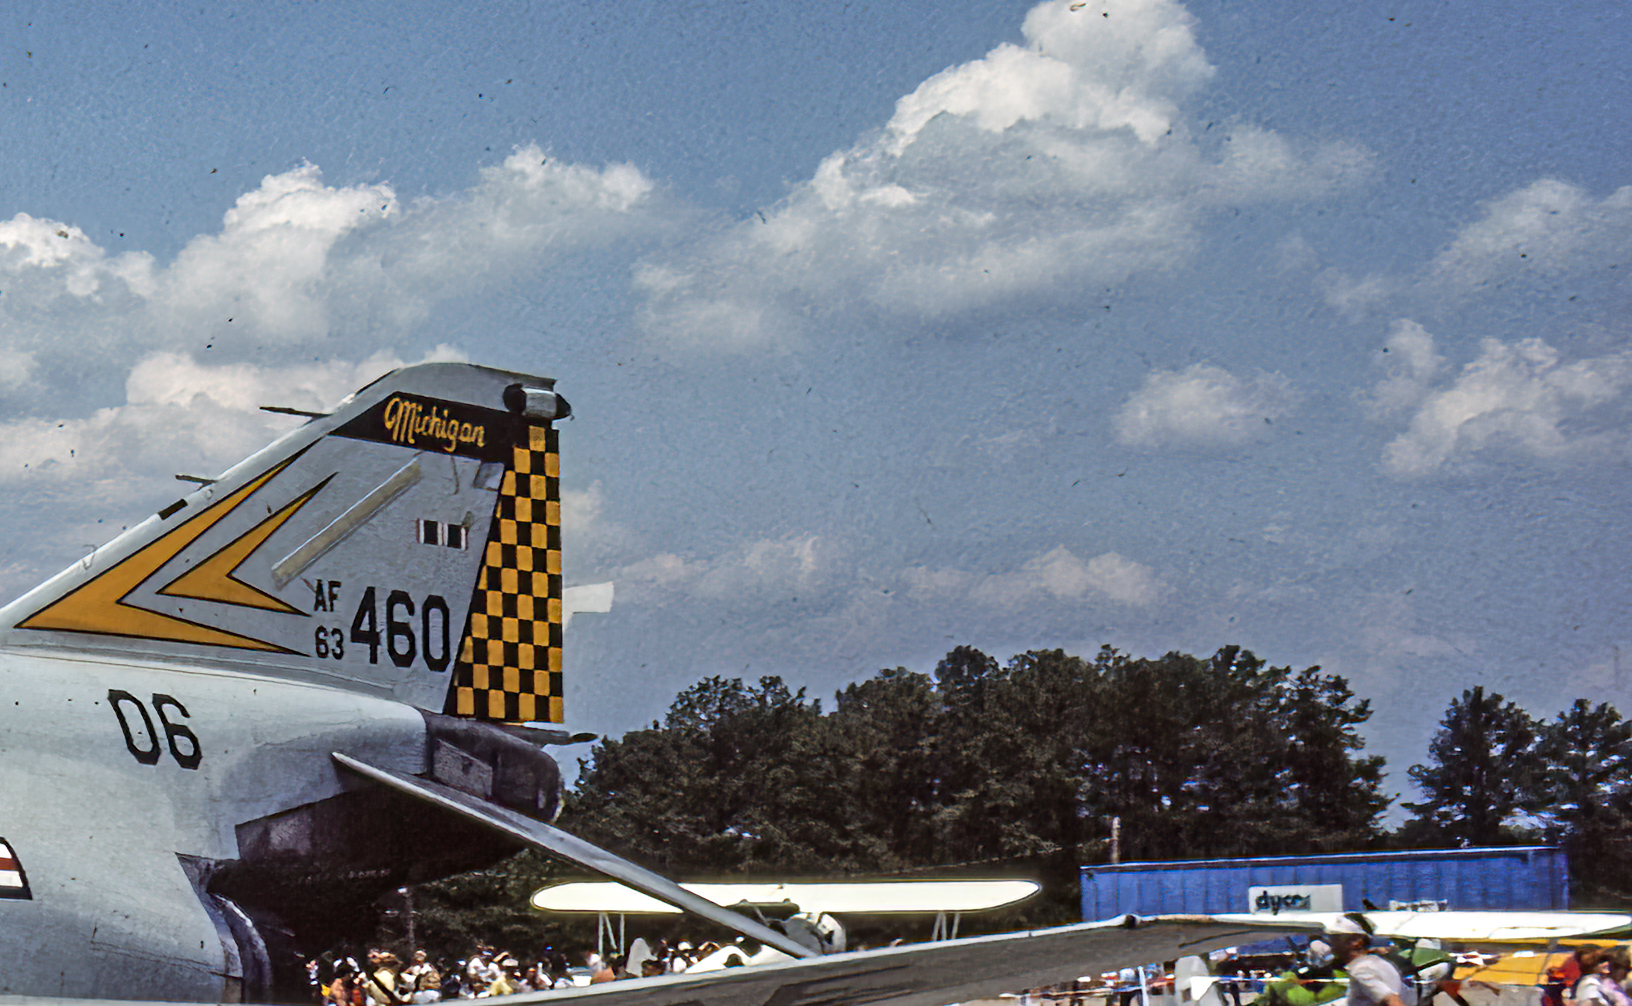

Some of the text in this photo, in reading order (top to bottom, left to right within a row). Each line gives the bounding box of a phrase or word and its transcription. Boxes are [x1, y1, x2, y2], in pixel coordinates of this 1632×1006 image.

[383, 396, 486, 453] Michigan
[313, 578, 342, 612] AF
[315, 625, 344, 660] 63
[350, 586, 451, 673] 460
[107, 688, 203, 771] 06
